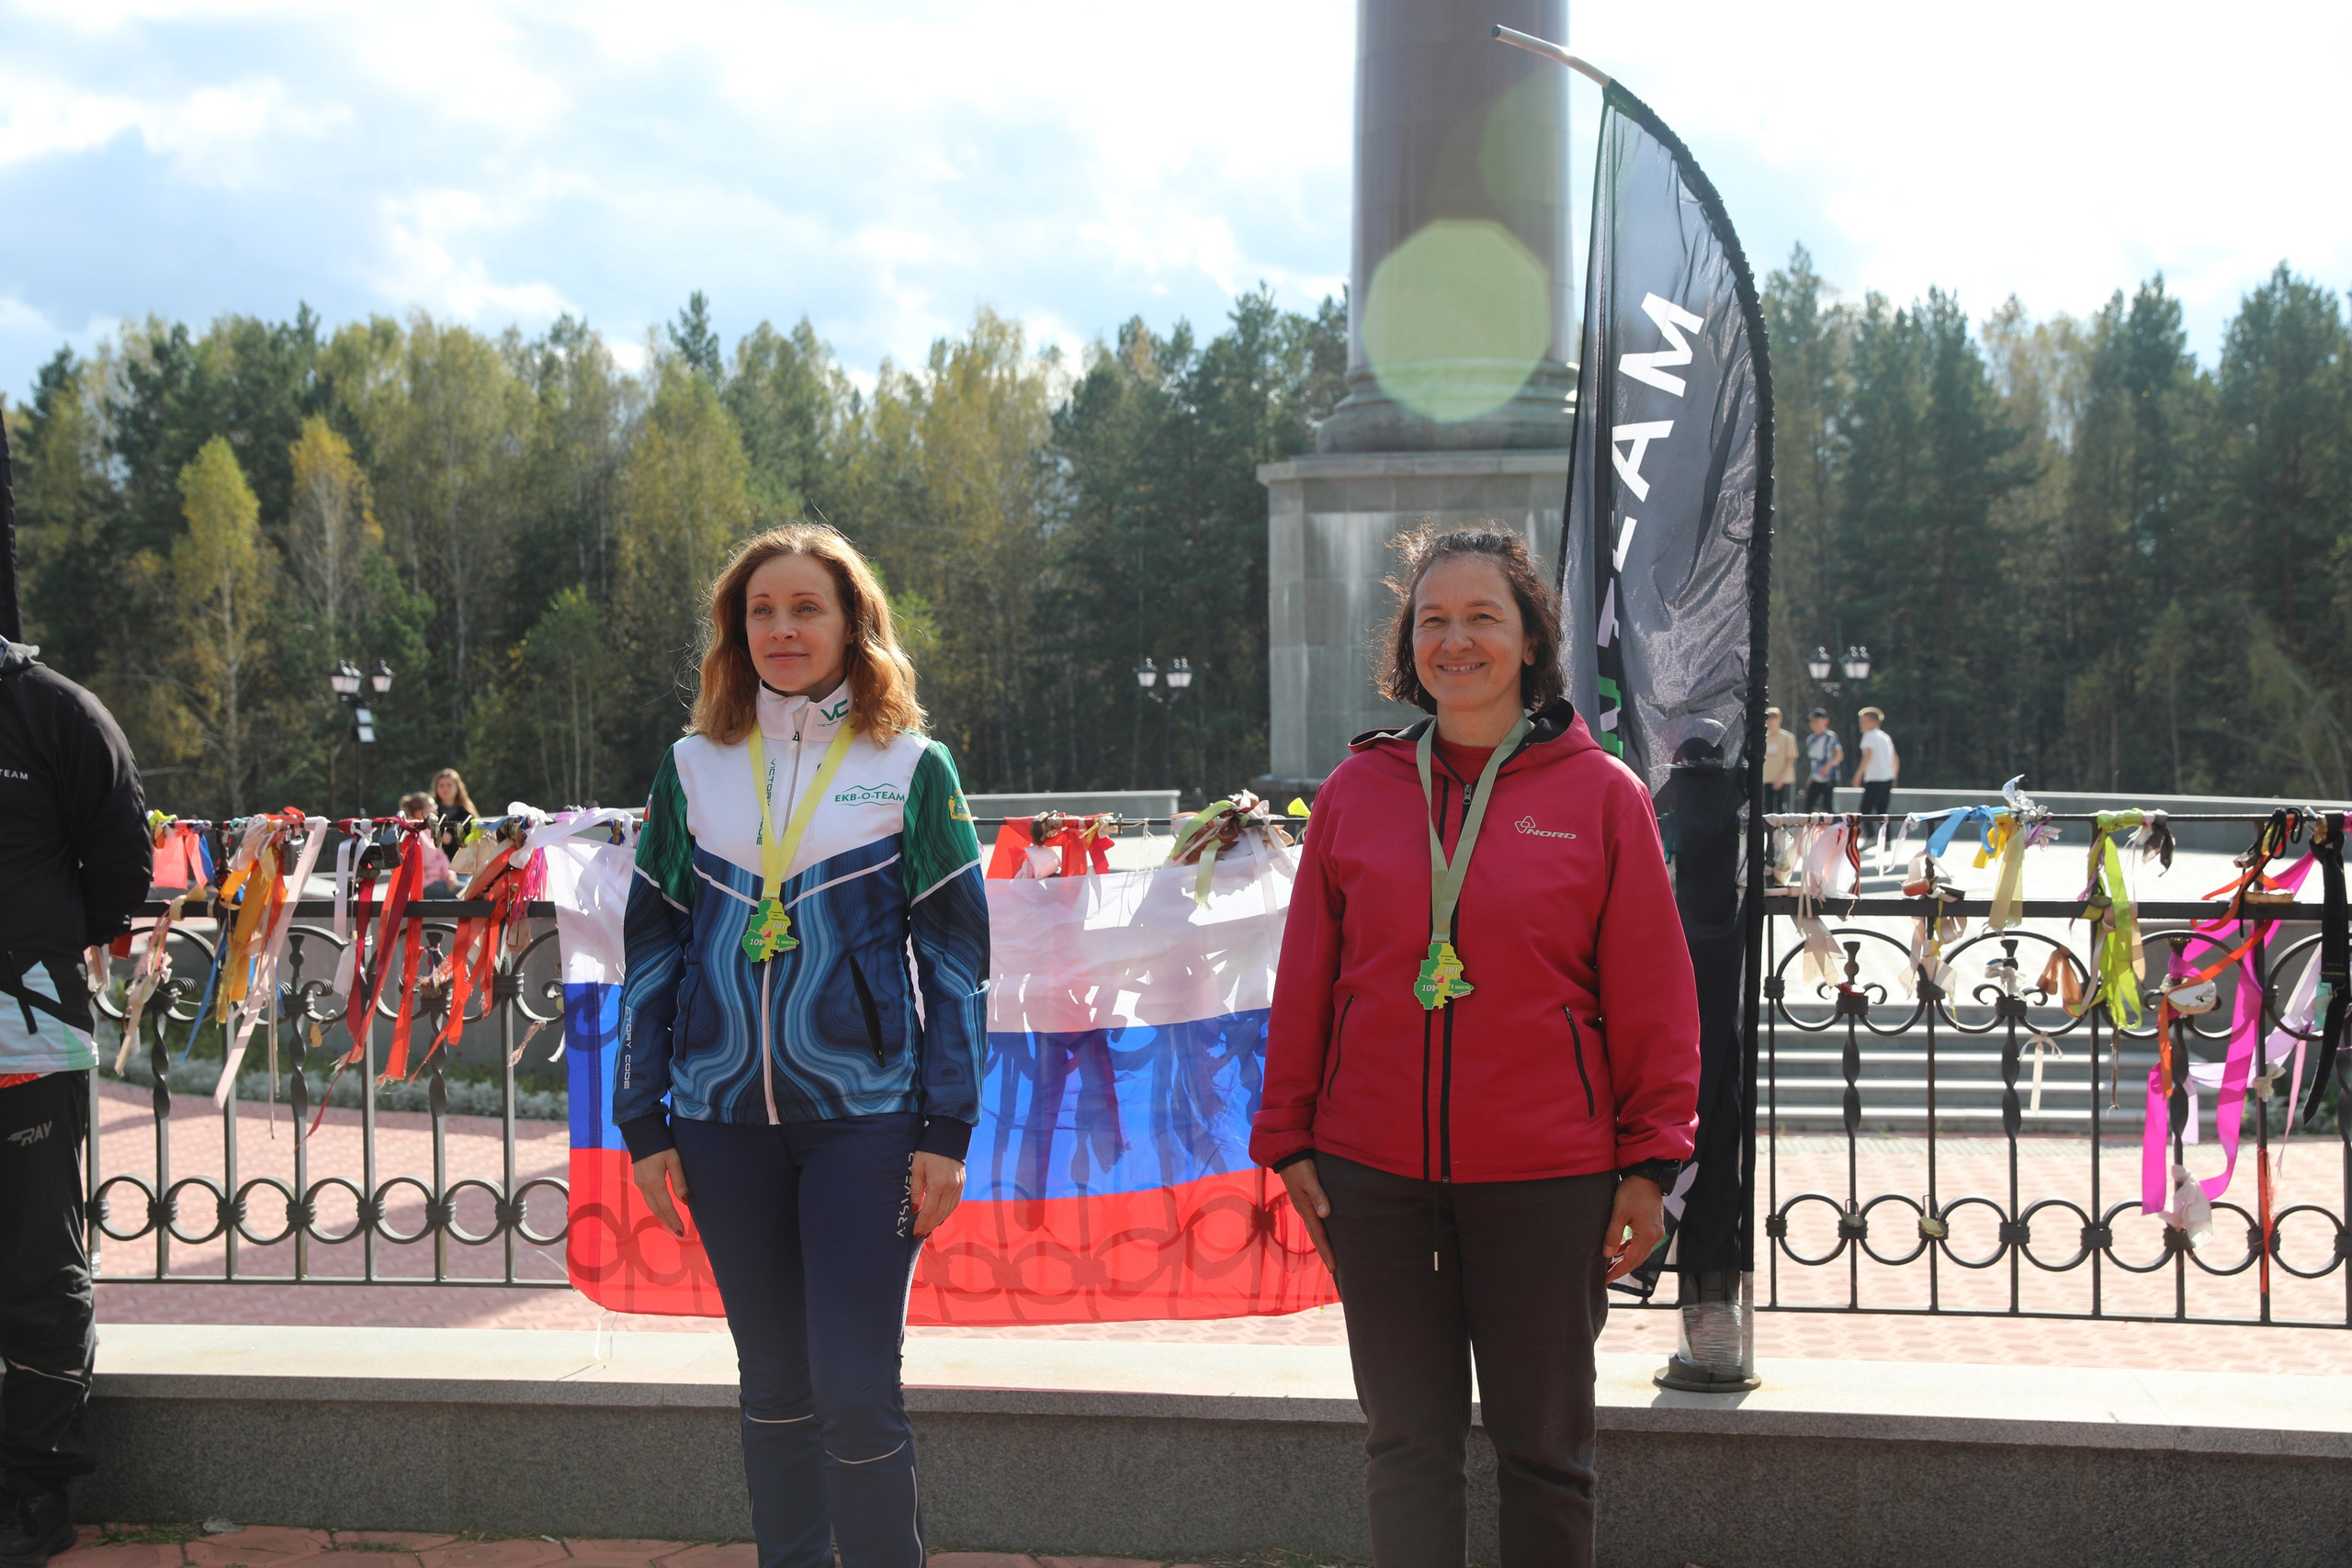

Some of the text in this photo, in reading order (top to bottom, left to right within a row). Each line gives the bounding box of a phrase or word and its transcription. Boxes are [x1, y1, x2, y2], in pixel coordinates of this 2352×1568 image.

[820, 698, 849, 721] VC
[835, 792, 905, 802] EKB-O-TEAM
[1526, 829, 1577, 840] NORD
[773, 921, 786, 930] 101
[750, 938, 763, 946] 101
[1421, 984, 1437, 992] 101
[623, 1055, 631, 1089] CODE
